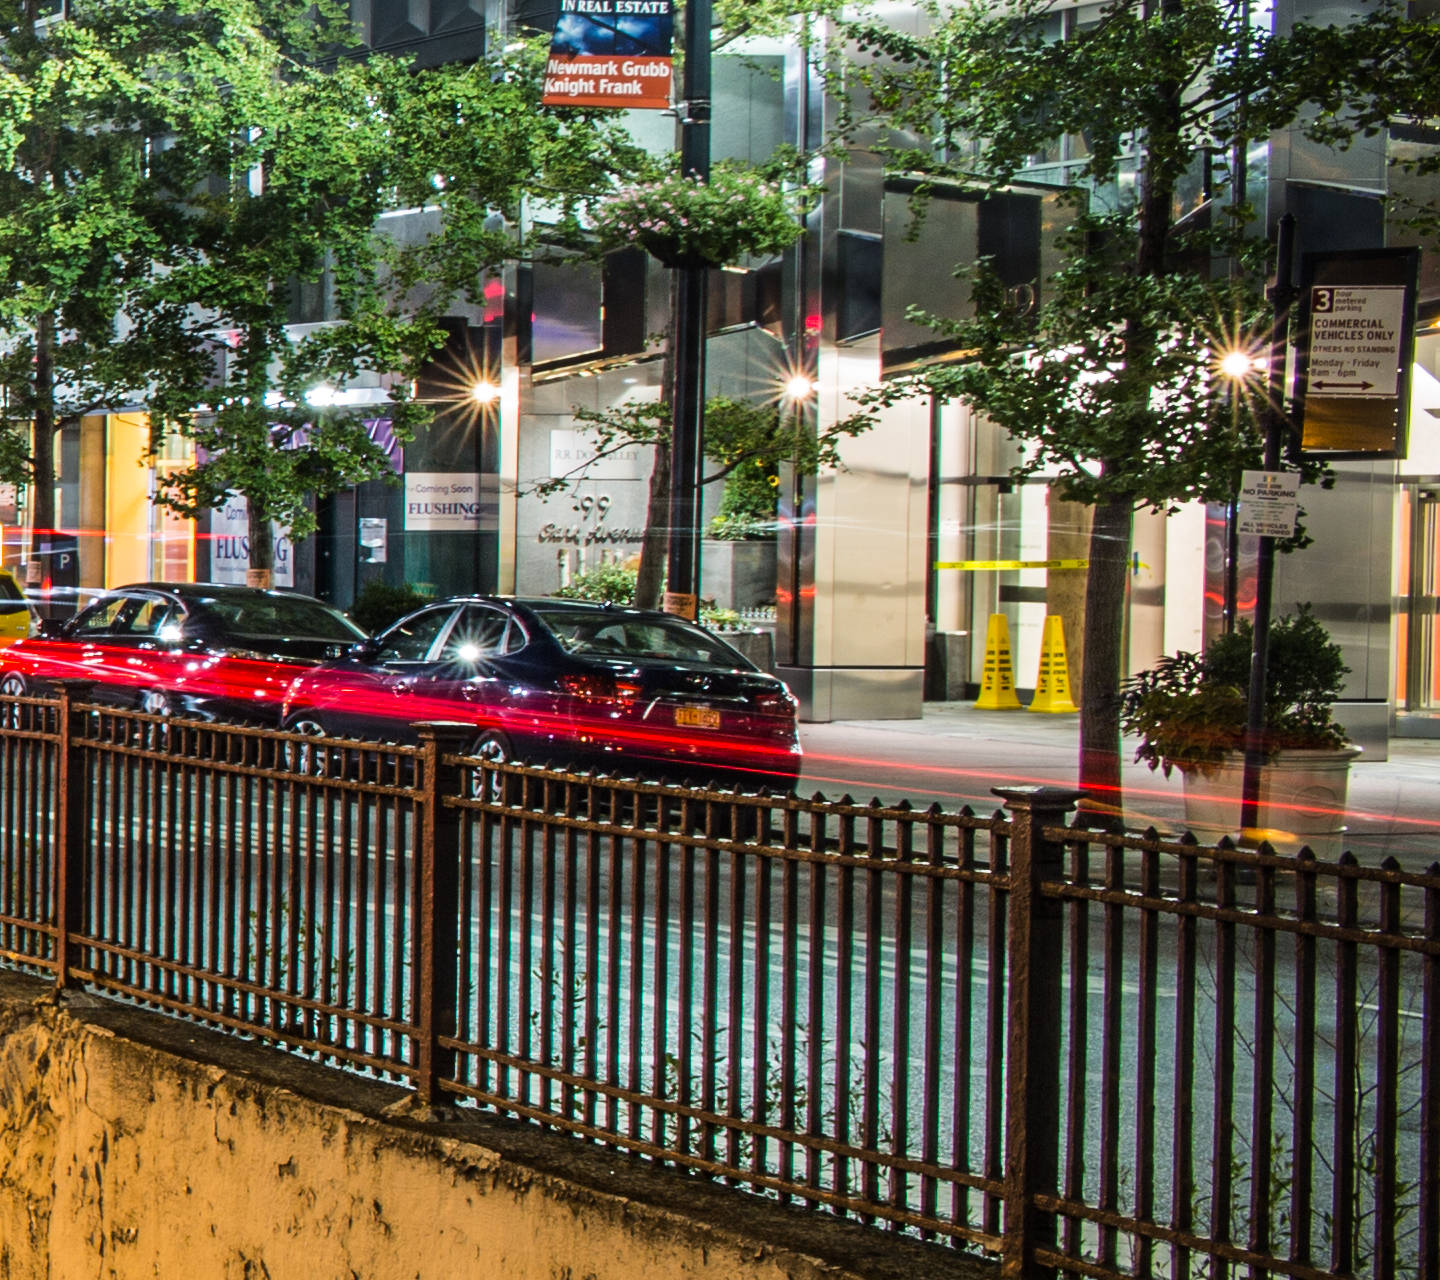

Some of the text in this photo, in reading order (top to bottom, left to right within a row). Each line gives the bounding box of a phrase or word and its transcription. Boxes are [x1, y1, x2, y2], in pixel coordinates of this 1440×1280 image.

[561, 0, 669, 14] IN REAL ESTATE
[548, 59, 669, 77] Newmark Grubb
[544, 78, 642, 96] Knight Frank
[1316, 290, 1352, 311] 3 hour
[1335, 305, 1362, 313] parking
[1314, 320, 1384, 329] COMMERCIAL
[1314, 331, 1394, 341] VEHICLES ONLY
[1312, 345, 1396, 354] OTHERS NO STANDING
[1312, 359, 1344, 368] Monday
[1352, 359, 1380, 368] Friday
[1311, 369, 1330, 377] 8am
[1337, 369, 1357, 378] 6pm
[416, 483, 473, 495] Coming Soon
[1257, 489, 1296, 497] PARKING
[408, 502, 480, 515] FLUSHING
[581, 496, 610, 521] 99
[538, 523, 580, 545] Park
[60, 555, 70, 569] P
